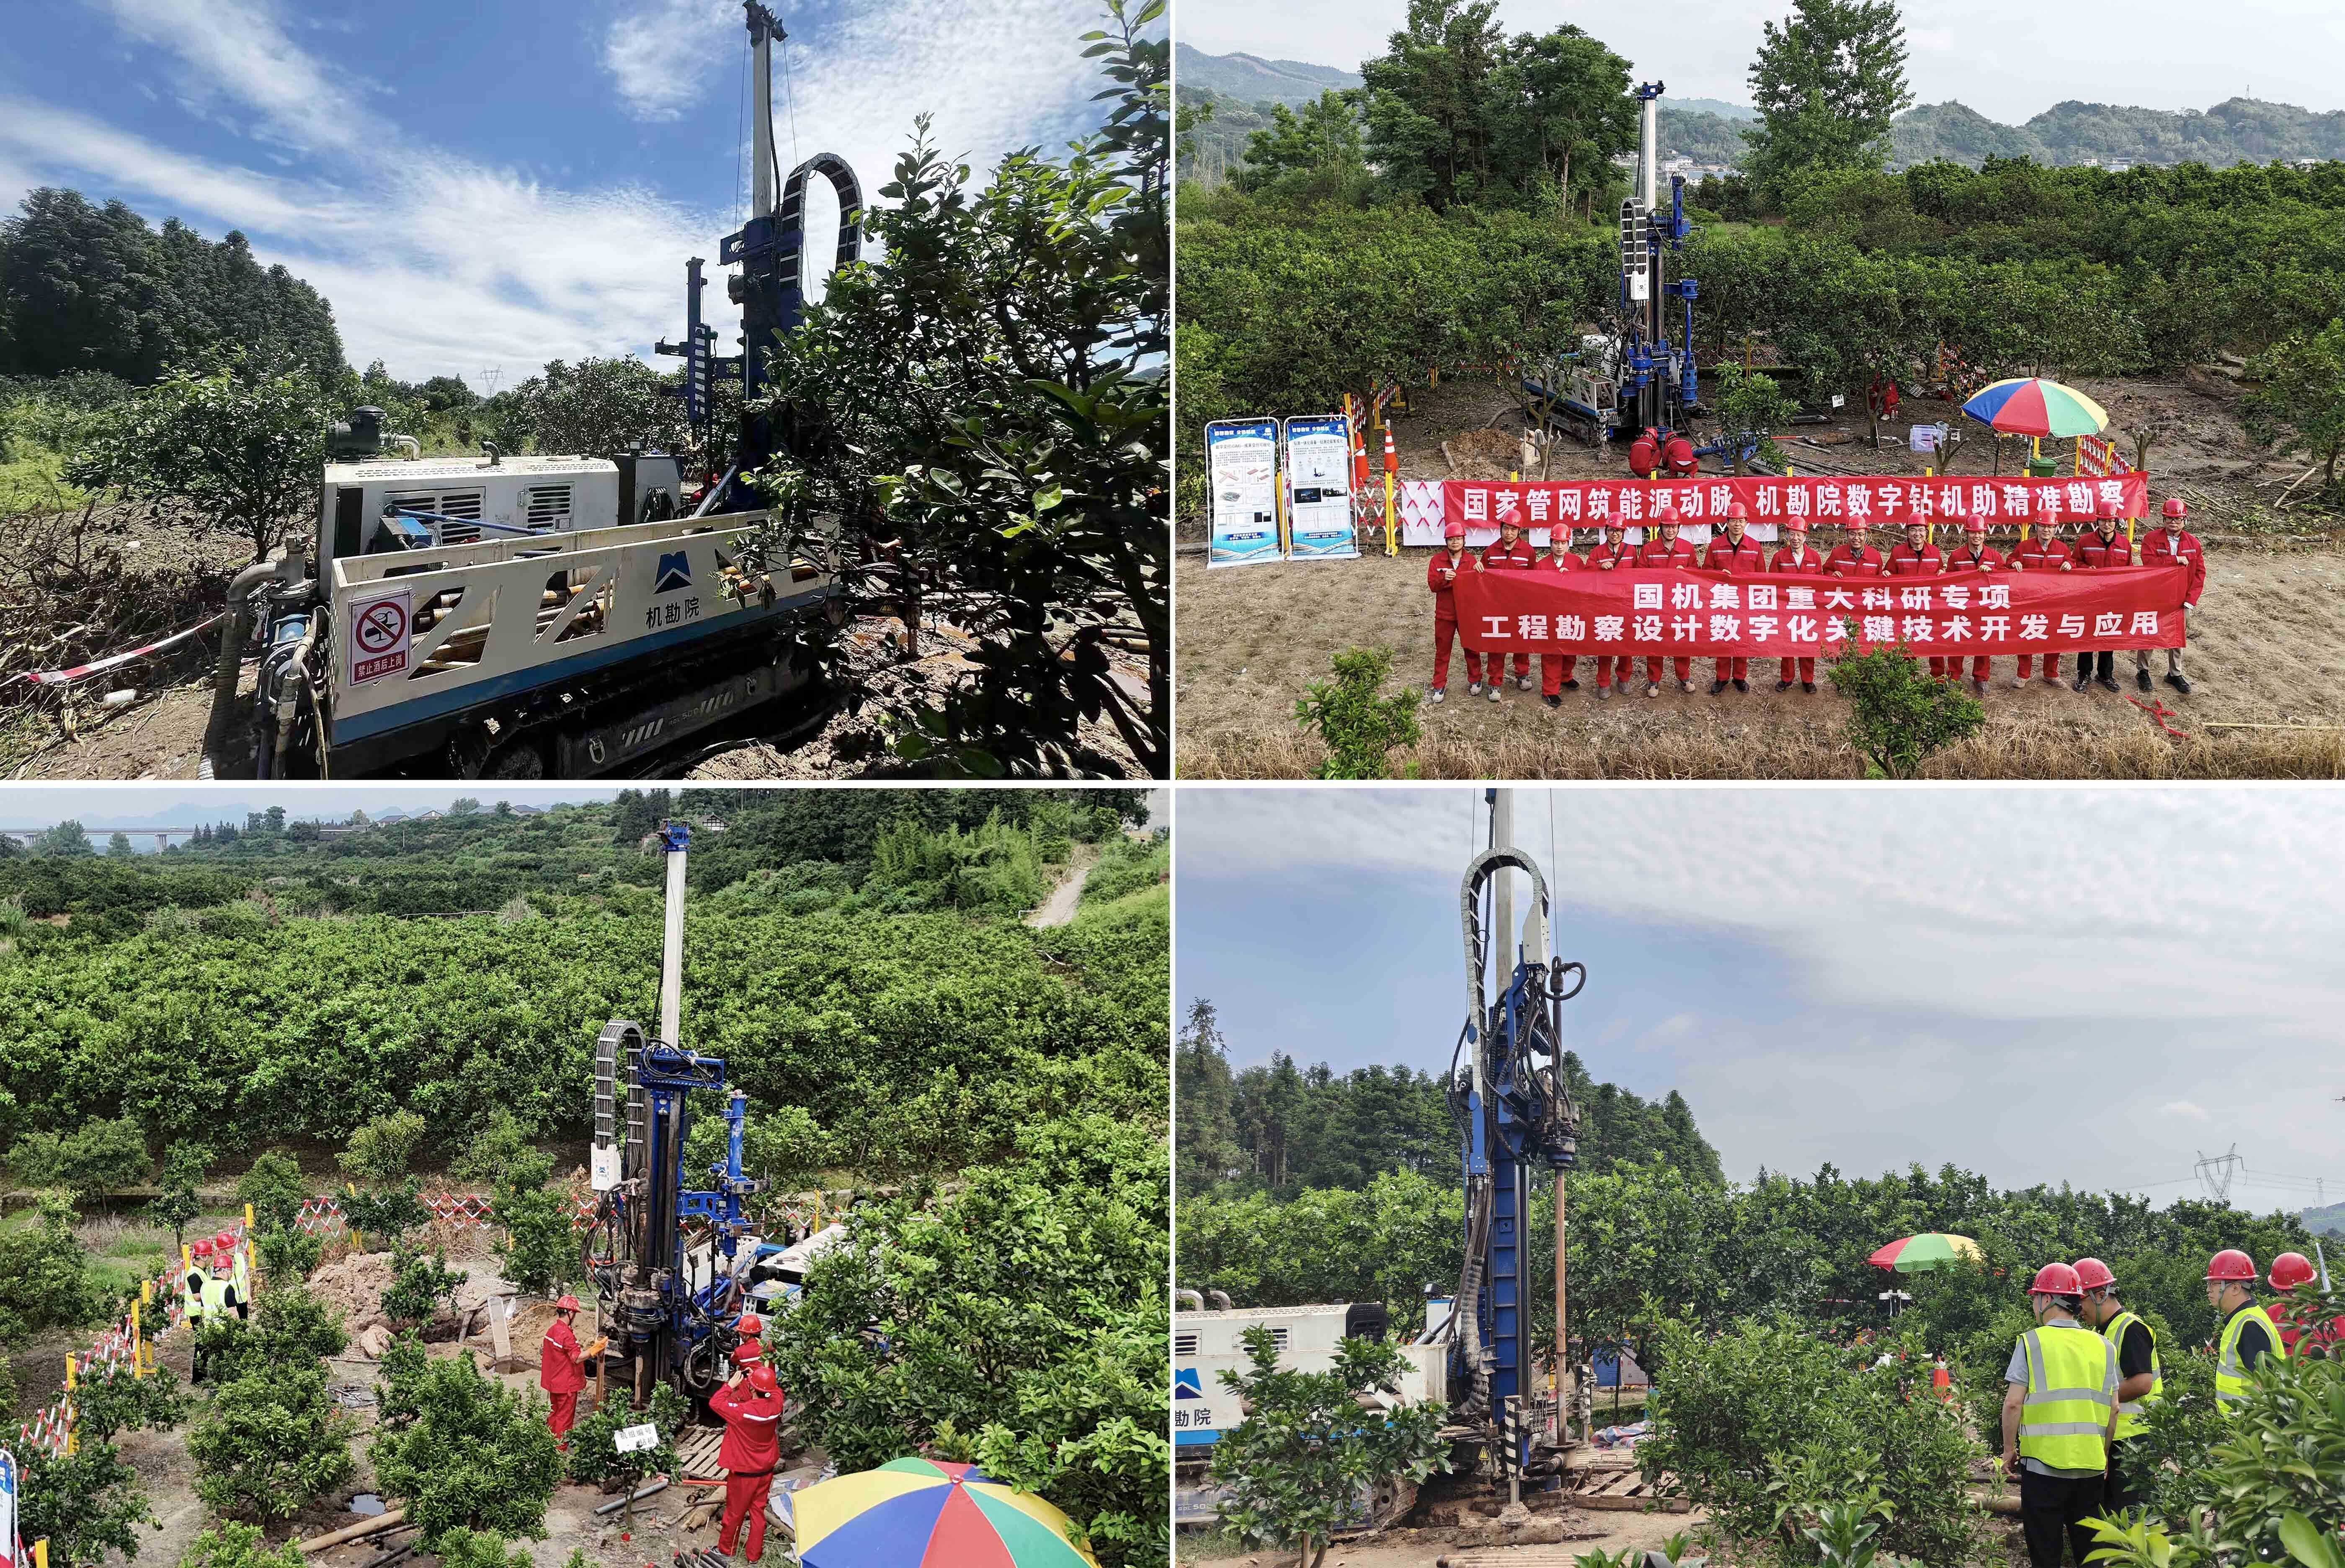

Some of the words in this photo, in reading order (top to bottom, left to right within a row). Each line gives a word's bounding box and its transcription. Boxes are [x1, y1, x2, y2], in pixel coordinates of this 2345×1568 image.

[1464, 484, 1734, 521] 国家管网筑能源动脉
[1756, 480, 2124, 517] 机勘院数字钻机助精准勘察
[1634, 583, 2011, 611] 国机集团重大科研专项
[646, 596, 699, 629] 机勘院
[1481, 611, 2158, 642] 工程勘察设计数字化关键技术开发与应用
[358, 654, 402, 677] 禁止酒后上岗
[1175, 1408, 1211, 1427] 勘院
[620, 1427, 651, 1439] 机组编号
